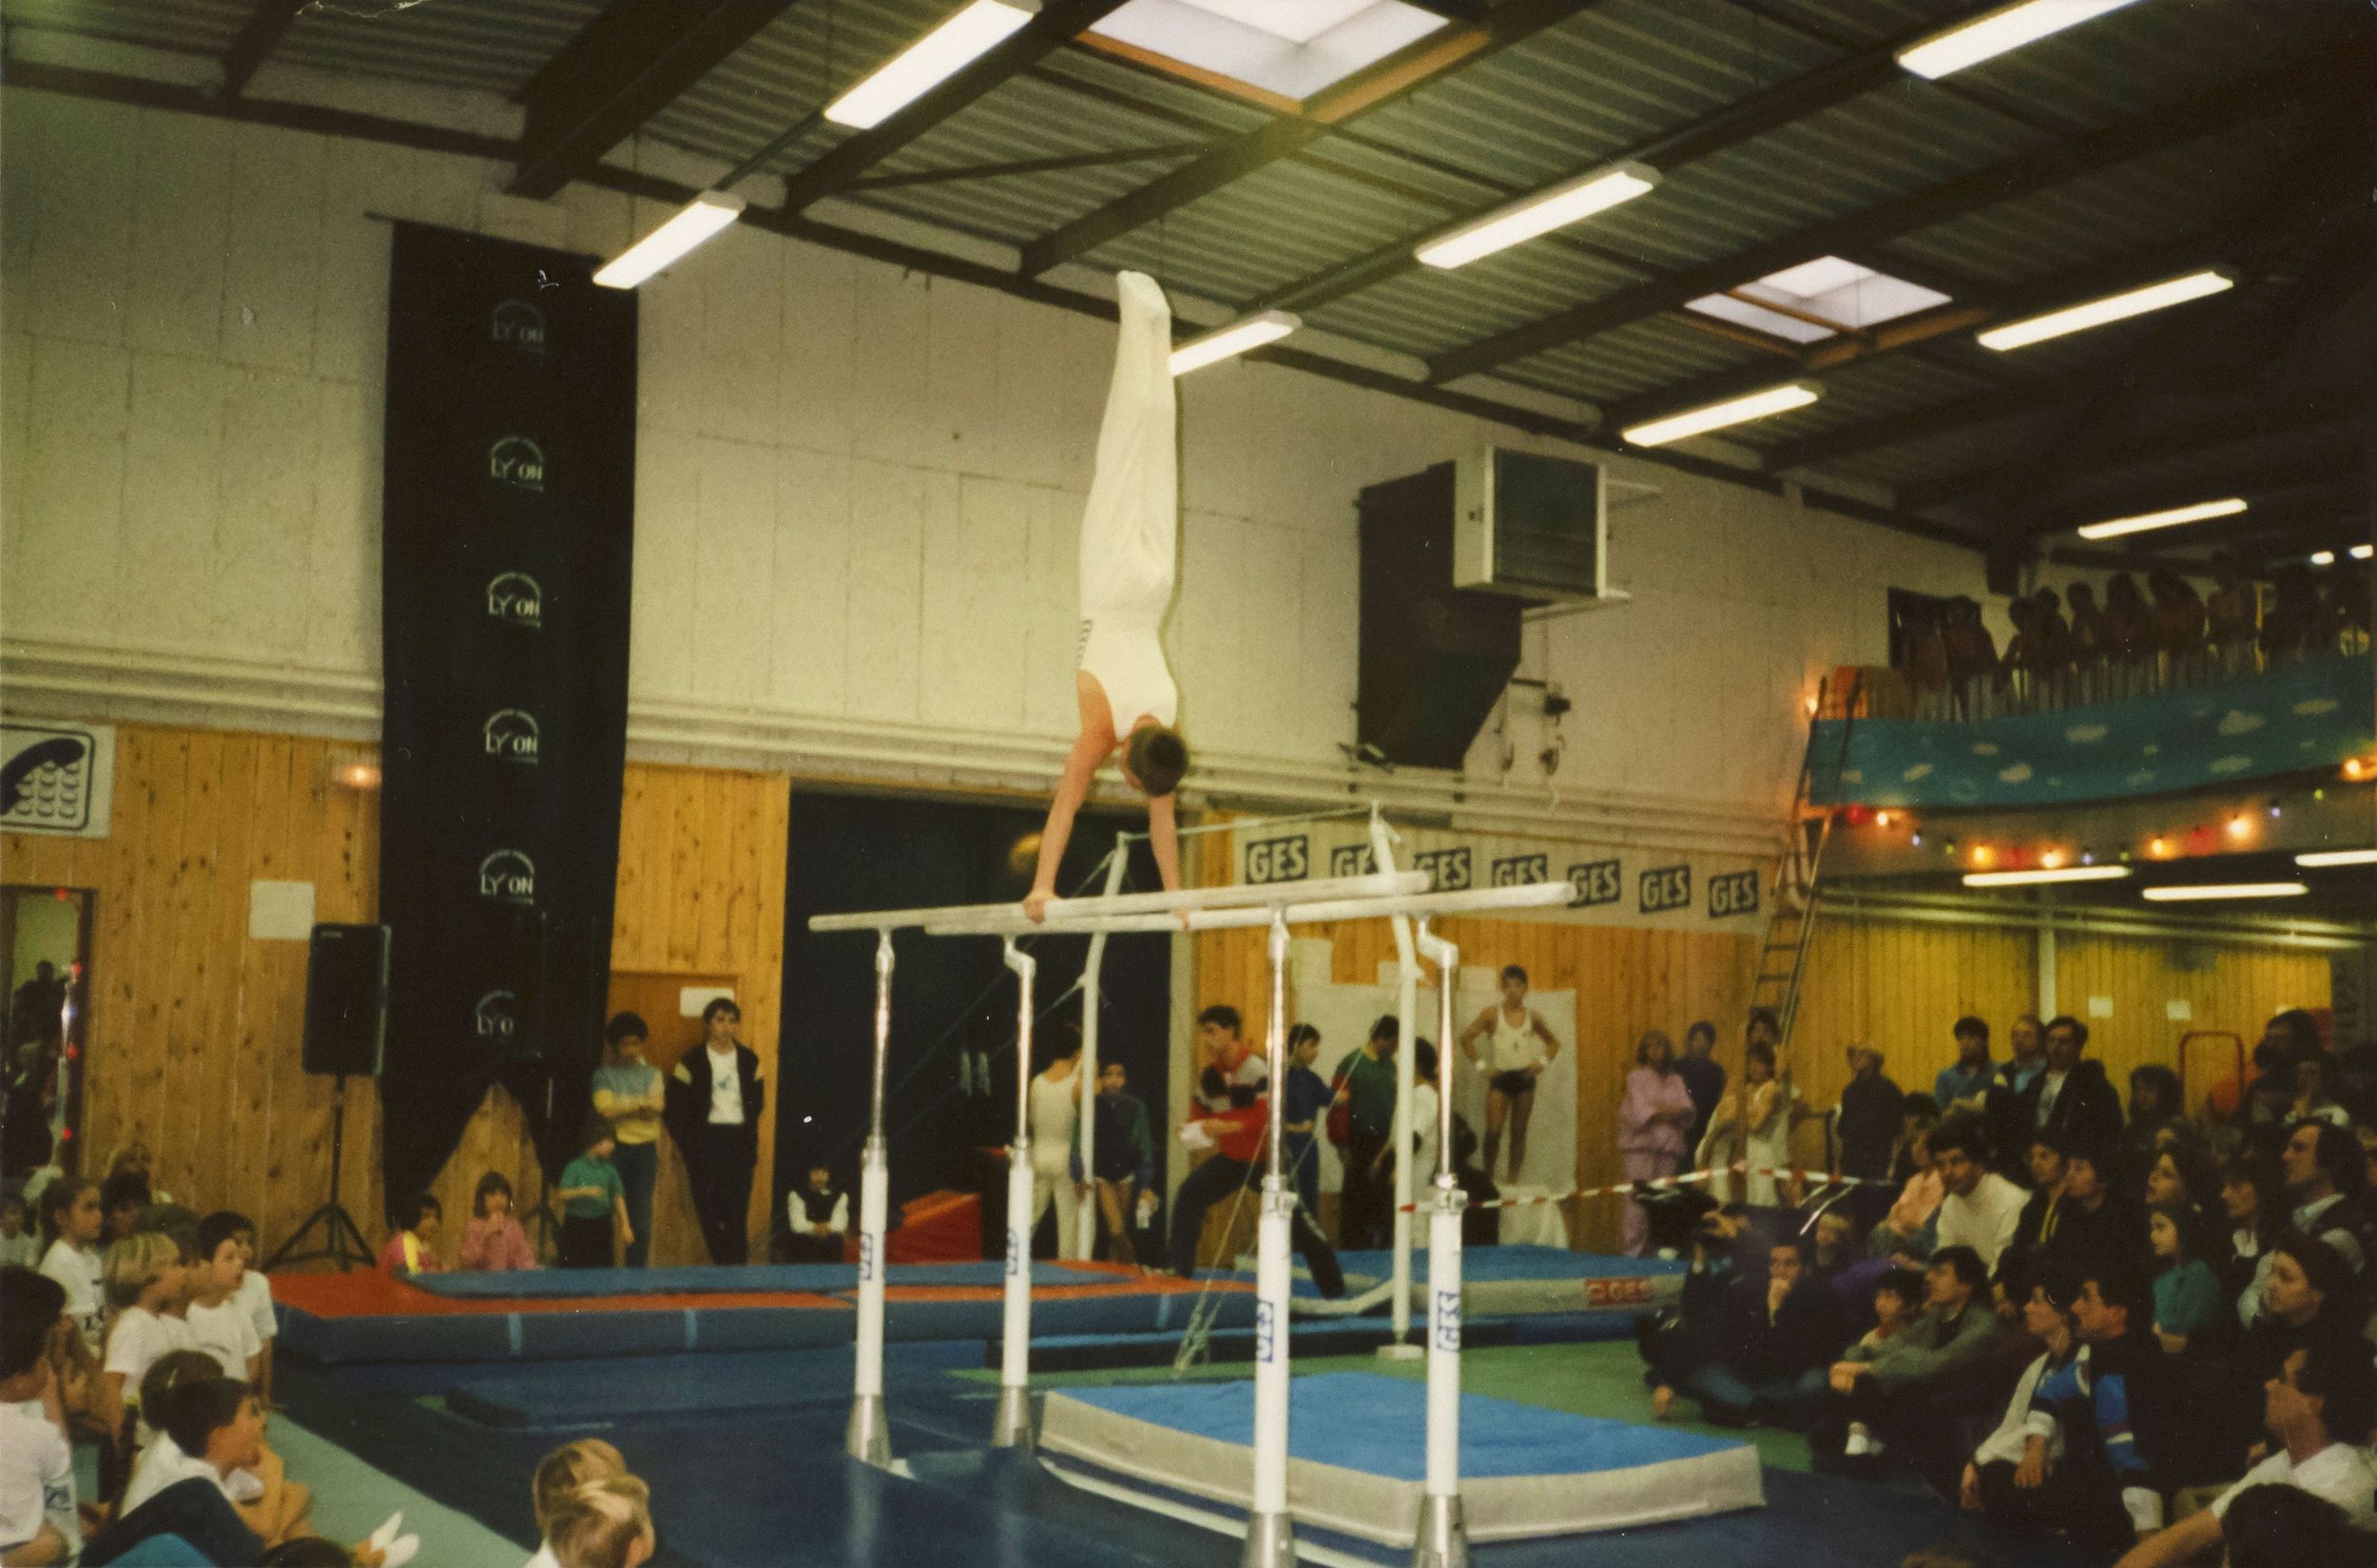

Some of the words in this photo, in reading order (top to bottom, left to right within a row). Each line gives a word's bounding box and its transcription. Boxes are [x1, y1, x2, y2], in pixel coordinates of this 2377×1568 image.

[1247, 837, 1306, 882] GES
[1572, 862, 1617, 901] GES
[1642, 869, 1689, 909] GES
[1711, 875, 1755, 912] GES
